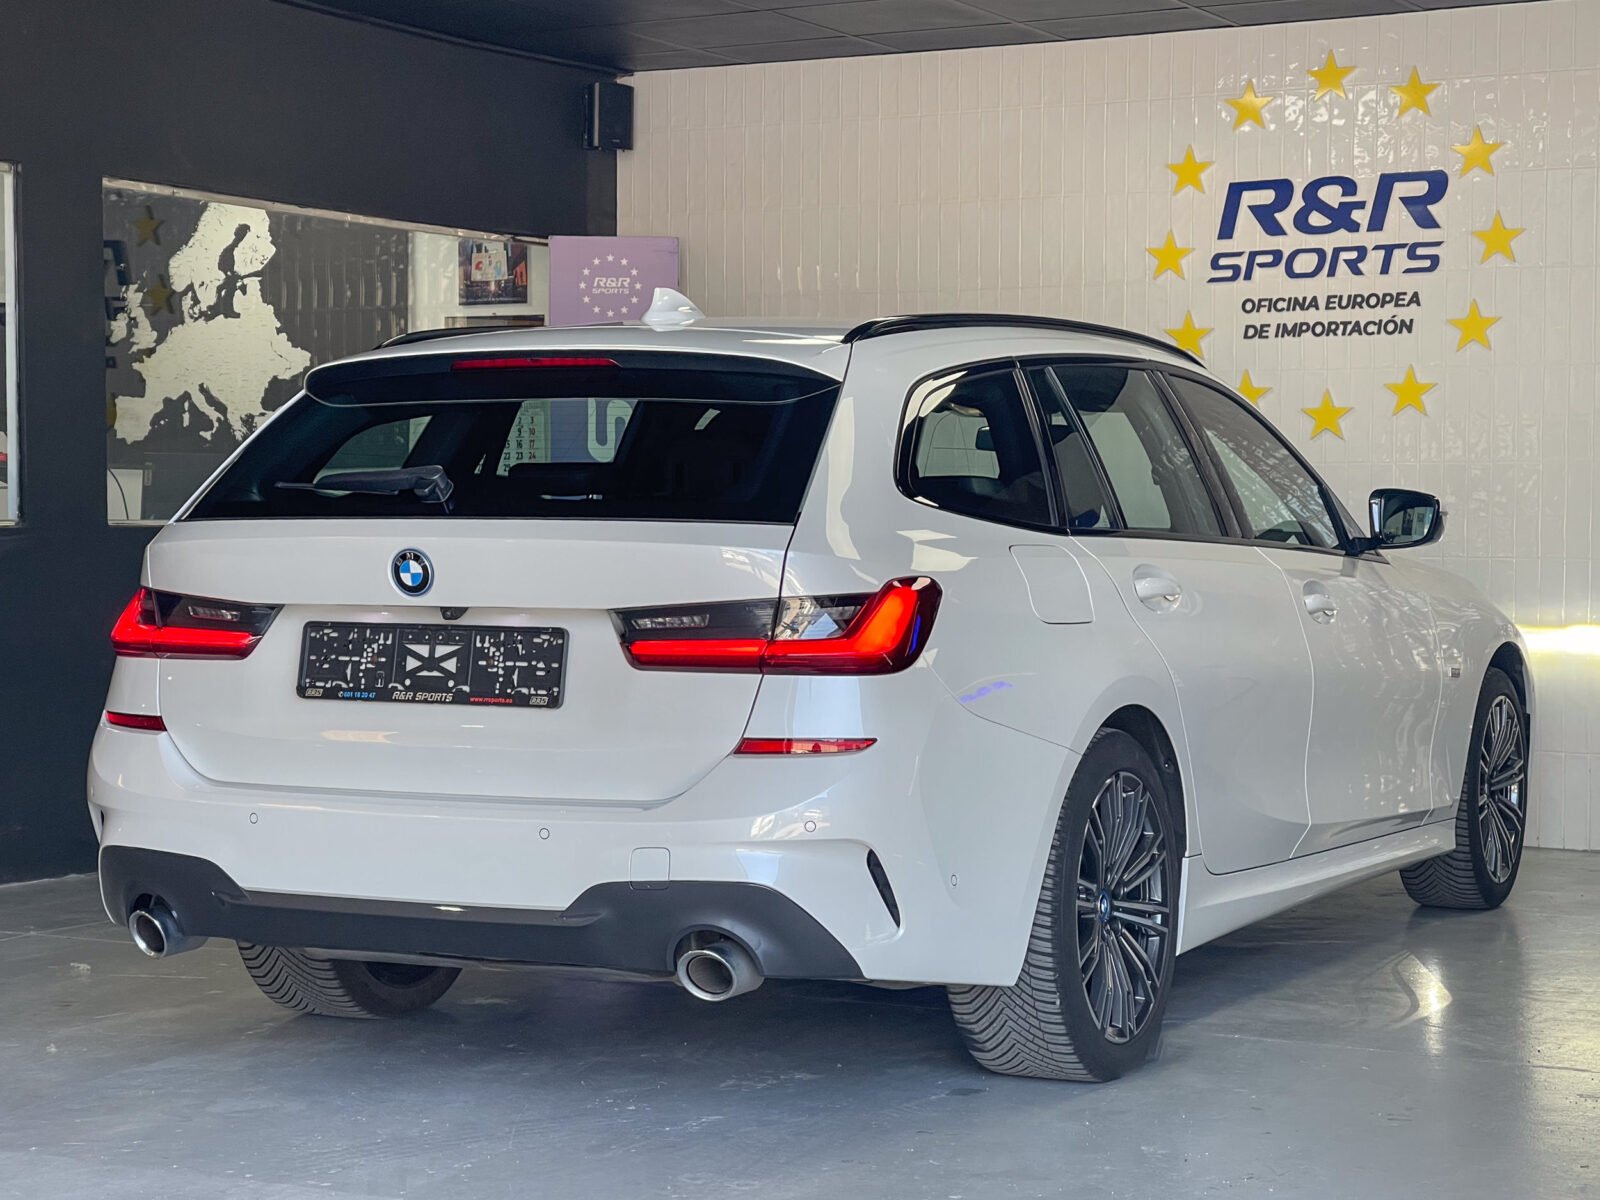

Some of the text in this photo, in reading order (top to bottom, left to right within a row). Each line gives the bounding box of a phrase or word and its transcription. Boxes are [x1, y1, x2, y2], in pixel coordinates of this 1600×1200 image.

[1217, 169, 1449, 240] R&R
[1206, 240, 1444, 283] SPORTS
[593, 276, 631, 288] R&R
[592, 287, 630, 295] SPORTS
[1241, 291, 1421, 314] OFICINA EUROPEA
[1243, 315, 1414, 340] DE IMPORTACIÓN
[516, 439, 523, 449] 16
[516, 451, 523, 460] 23
[392, 691, 454, 702] R&R SPORTS
